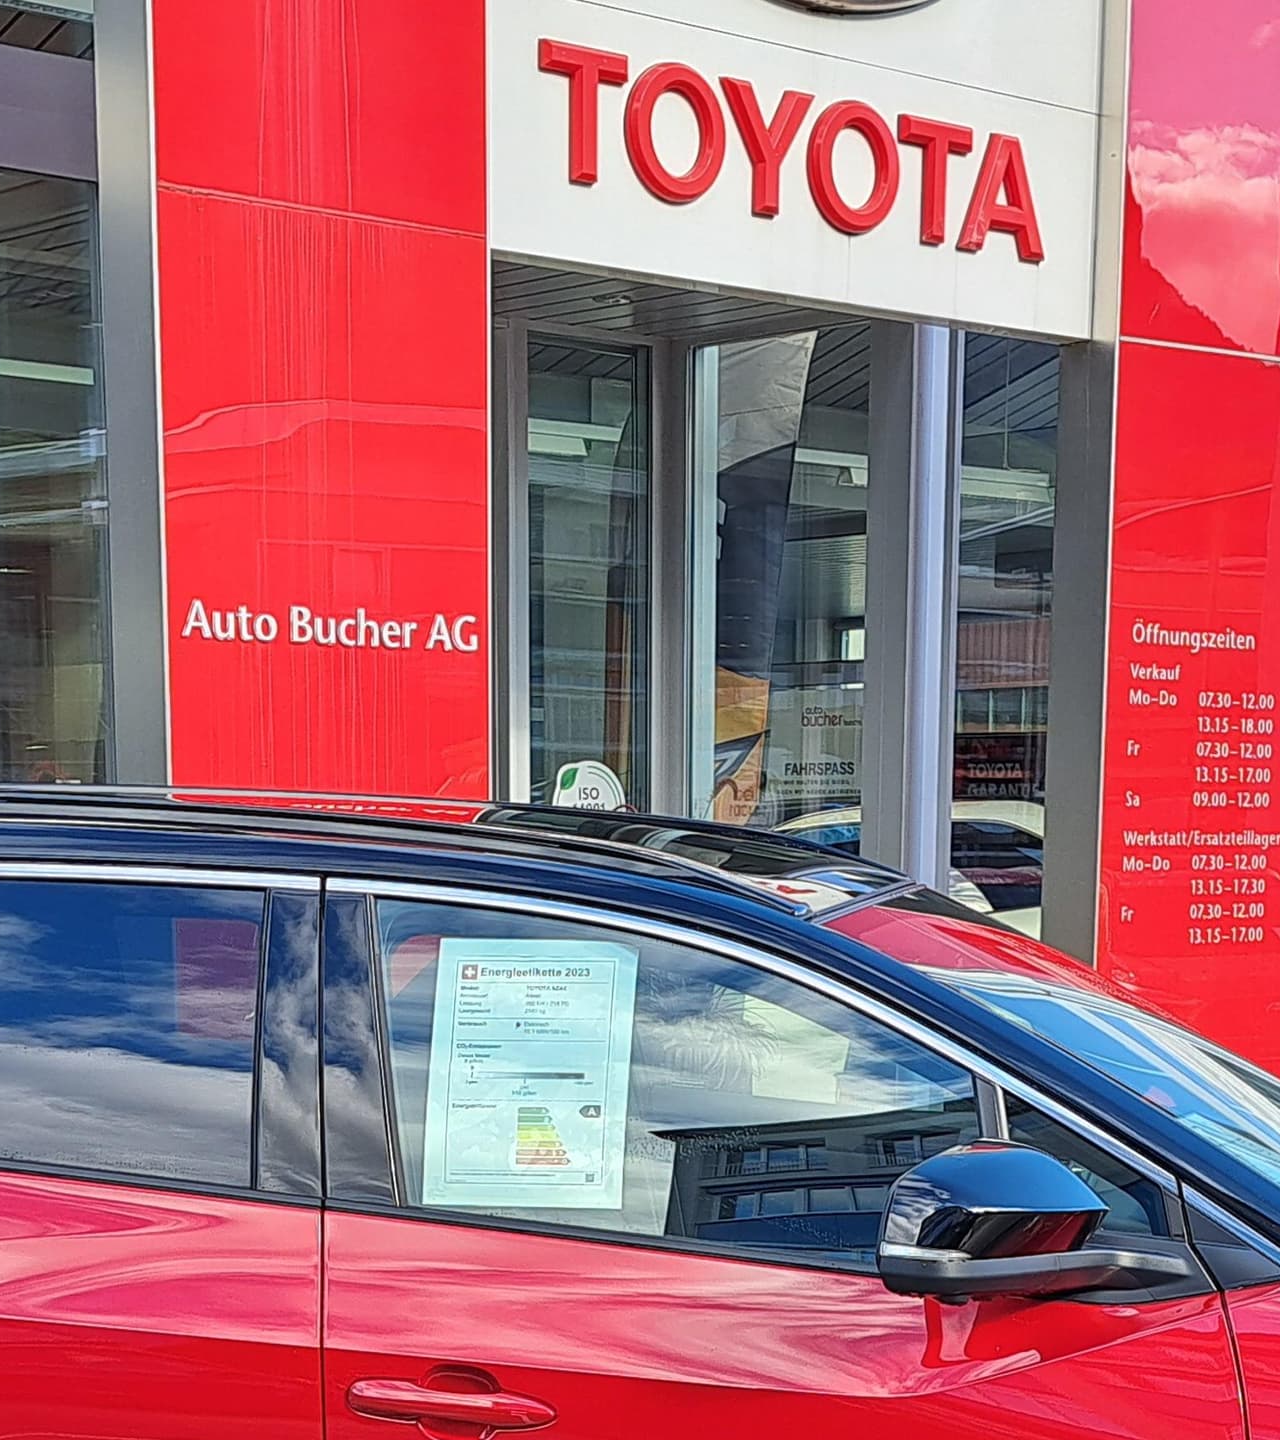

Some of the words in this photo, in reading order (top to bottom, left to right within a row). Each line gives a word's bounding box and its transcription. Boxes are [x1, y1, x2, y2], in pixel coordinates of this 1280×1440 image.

[538, 38, 1045, 264] TOYOTA
[182, 598, 277, 642] Auto
[289, 605, 417, 649] Bucher
[425, 615, 479, 652] AG
[1132, 618, 1256, 653] Öffnungszeiten
[1130, 663, 1181, 681] Verkauf
[1128, 689, 1178, 706] Mo-Do
[1198, 692, 1275, 710] 07.30-12.00
[801, 711, 843, 727] bucher
[1127, 740, 1141, 756] Fr
[1196, 742, 1272, 759] 07.30-12.00
[784, 762, 855, 776] FAHRSPASS
[967, 763, 1024, 778] TOYOTA
[579, 787, 600, 800] ISO
[1125, 791, 1140, 807] Sa
[1122, 856, 1170, 872] Mo-Do
[1191, 854, 1267, 870] 07.30-12.00
[1121, 906, 1134, 922] Fr
[480, 966, 562, 979] Energieetikette
[564, 967, 591, 978] 2023
